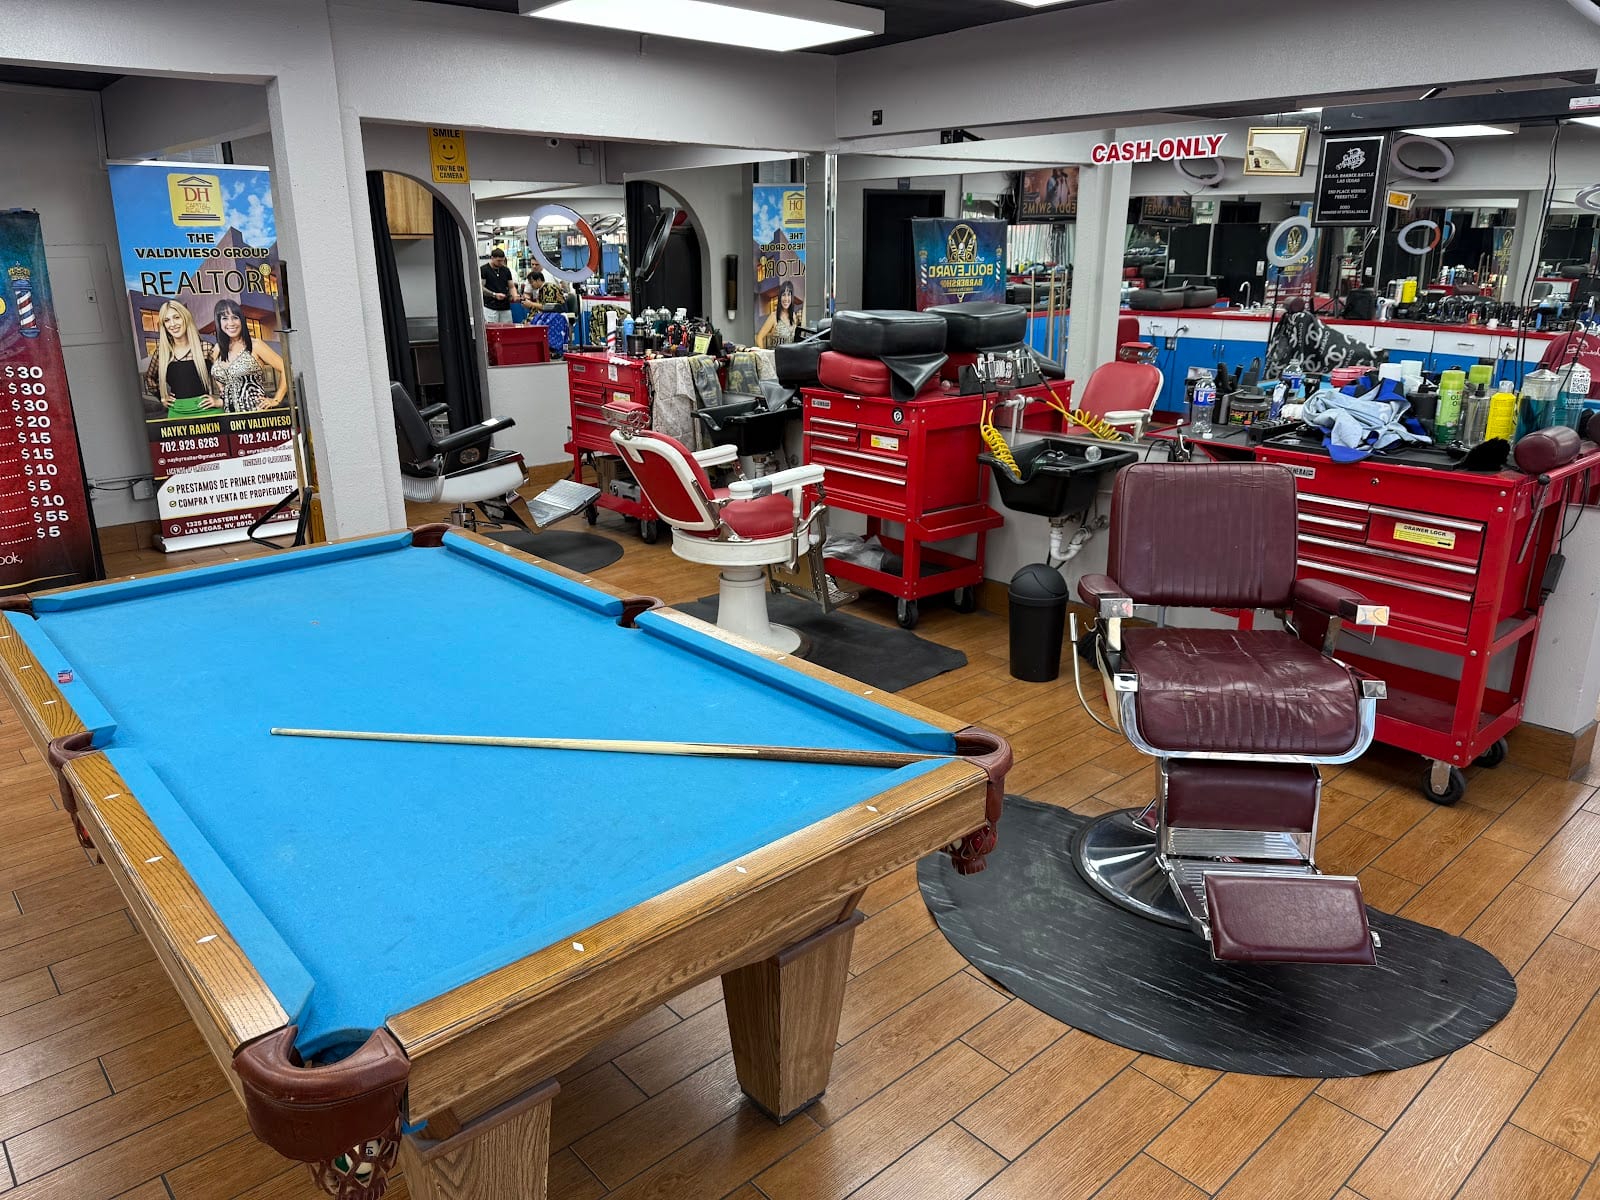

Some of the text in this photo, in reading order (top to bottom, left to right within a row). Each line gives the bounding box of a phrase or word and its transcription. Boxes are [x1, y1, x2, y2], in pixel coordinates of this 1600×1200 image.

[433, 128, 460, 138] SMILE
[1092, 135, 1224, 163] CASH ONLY
[183, 187, 210, 202] DH
[187, 233, 214, 243] THE
[135, 248, 269, 259] VALDIVIESO GROUP
[140, 270, 264, 296] REALTOR
[160, 415, 292, 438] NAYKY RANKIN ONY VALDIVIESO
[160, 430, 291, 453] 702.929.6263 702.241.4761
[176, 470, 297, 494] PRESTAMOS DE PRIMER COMPRADOR
[178, 484, 293, 508] COMPRA Y VENTA DE PROPIEDADES
[209, 515, 238, 525] EASTERN
[185, 527, 198, 535] LAS
[1404, 525, 1428, 533] DRAWER
